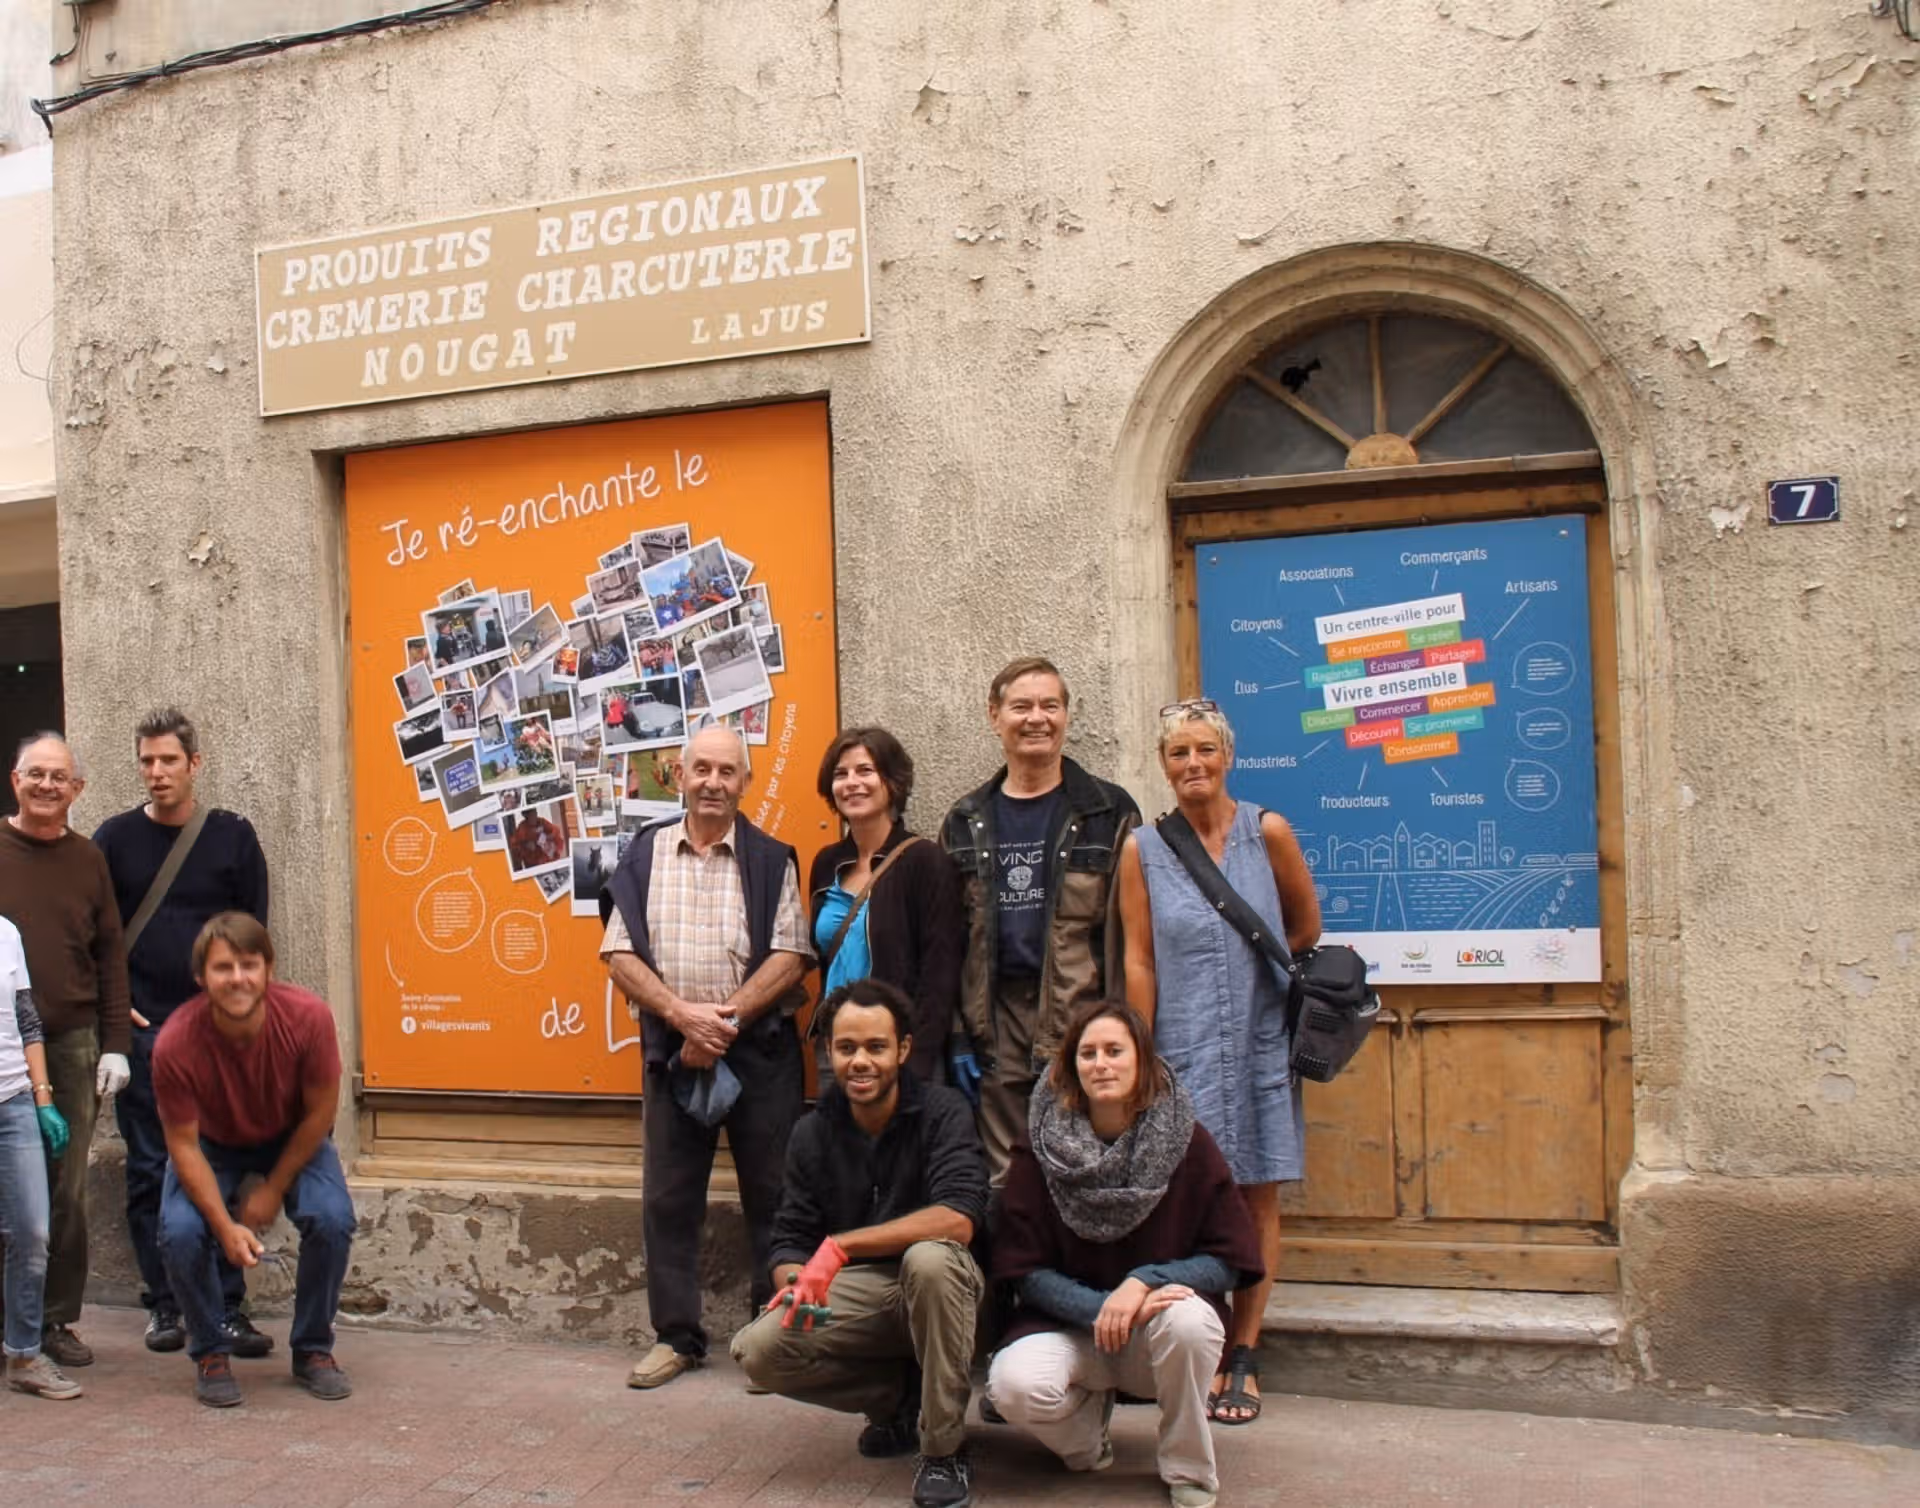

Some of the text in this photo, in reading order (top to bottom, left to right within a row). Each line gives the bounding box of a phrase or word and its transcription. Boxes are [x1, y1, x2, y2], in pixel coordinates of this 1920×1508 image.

[281, 176, 826, 296] PRODUITS REGIONAUX
[265, 228, 856, 349] CREMERIE CHARCUTERIE
[361, 301, 827, 387] NOUGAT LAJUS
[382, 449, 708, 567] Je ré-enchante le
[1790, 484, 1816, 517] 7
[1400, 547, 1488, 565] Commerçants
[1279, 566, 1354, 582] Associations
[1504, 579, 1558, 594] Artisans
[1231, 618, 1283, 634] Citoyens
[1323, 602, 1457, 635] Un centre-ville pour
[1431, 648, 1477, 665] Partager
[1331, 670, 1457, 703] Vivre ensemble
[1433, 689, 1489, 707] Apprendre
[1360, 702, 1422, 720] Commercer
[1426, 714, 1477, 733] promener
[1351, 726, 1400, 743] Découvrir
[1387, 739, 1451, 757] Consommer
[1236, 755, 1297, 769] Industriels
[1321, 795, 1390, 809] Producteurs
[1430, 792, 1485, 806] Touristes
[540, 996, 585, 1038] de
